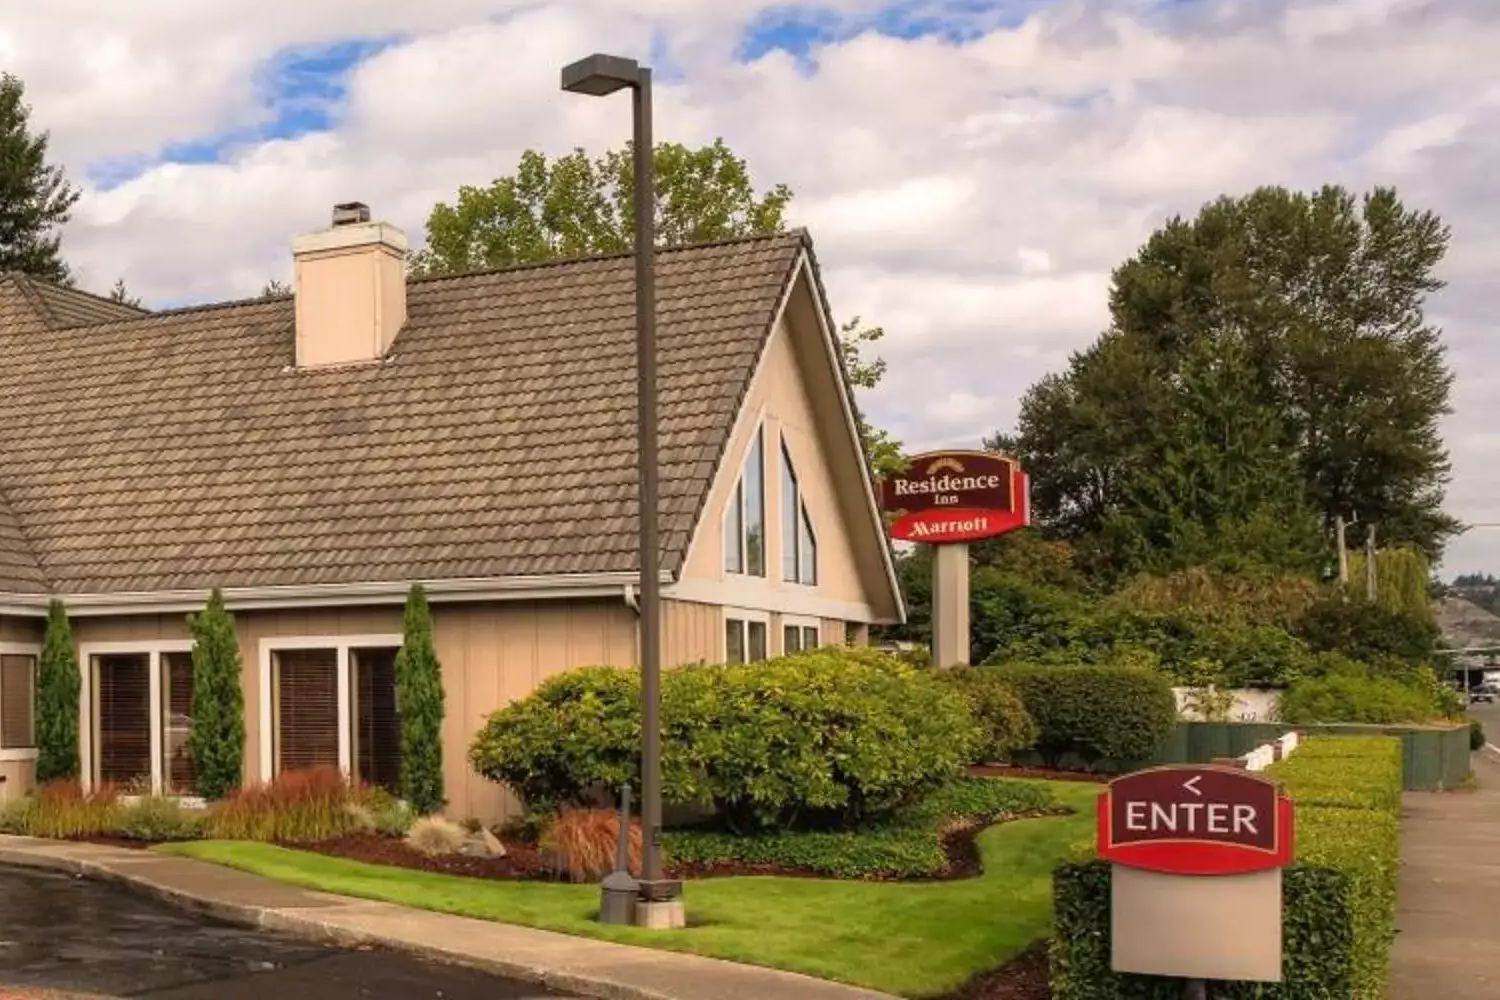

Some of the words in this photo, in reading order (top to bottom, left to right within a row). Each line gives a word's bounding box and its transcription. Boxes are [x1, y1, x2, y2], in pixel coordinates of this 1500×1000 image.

[894, 473, 1000, 496] Residence
[933, 494, 959, 505] Inn
[908, 517, 989, 537] Marriott
[1125, 801, 1259, 835] ENTER
